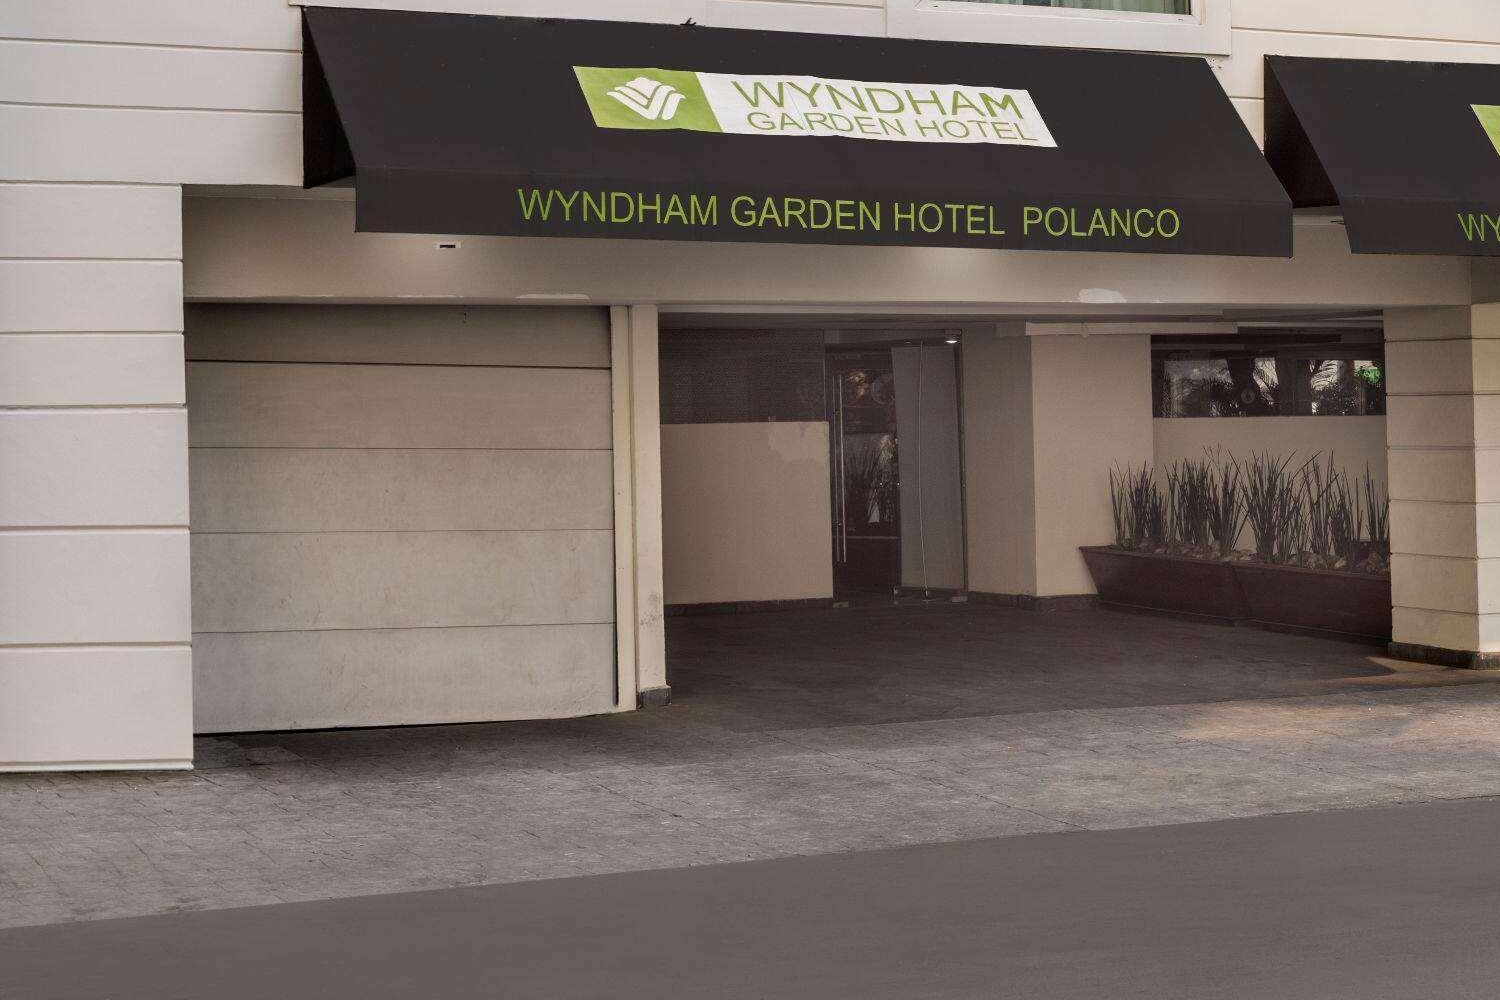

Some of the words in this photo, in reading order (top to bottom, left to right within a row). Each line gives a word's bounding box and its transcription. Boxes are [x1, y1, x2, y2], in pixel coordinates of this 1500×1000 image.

[731, 80, 1024, 120] WYNDHAM
[747, 112, 907, 136] GARDEN
[914, 119, 1038, 142] HOTEL
[518, 188, 718, 226] WYNDHAM
[731, 195, 881, 231] GARDEN
[895, 202, 1005, 235] HOTEL
[1023, 206, 1181, 238] POLANCO
